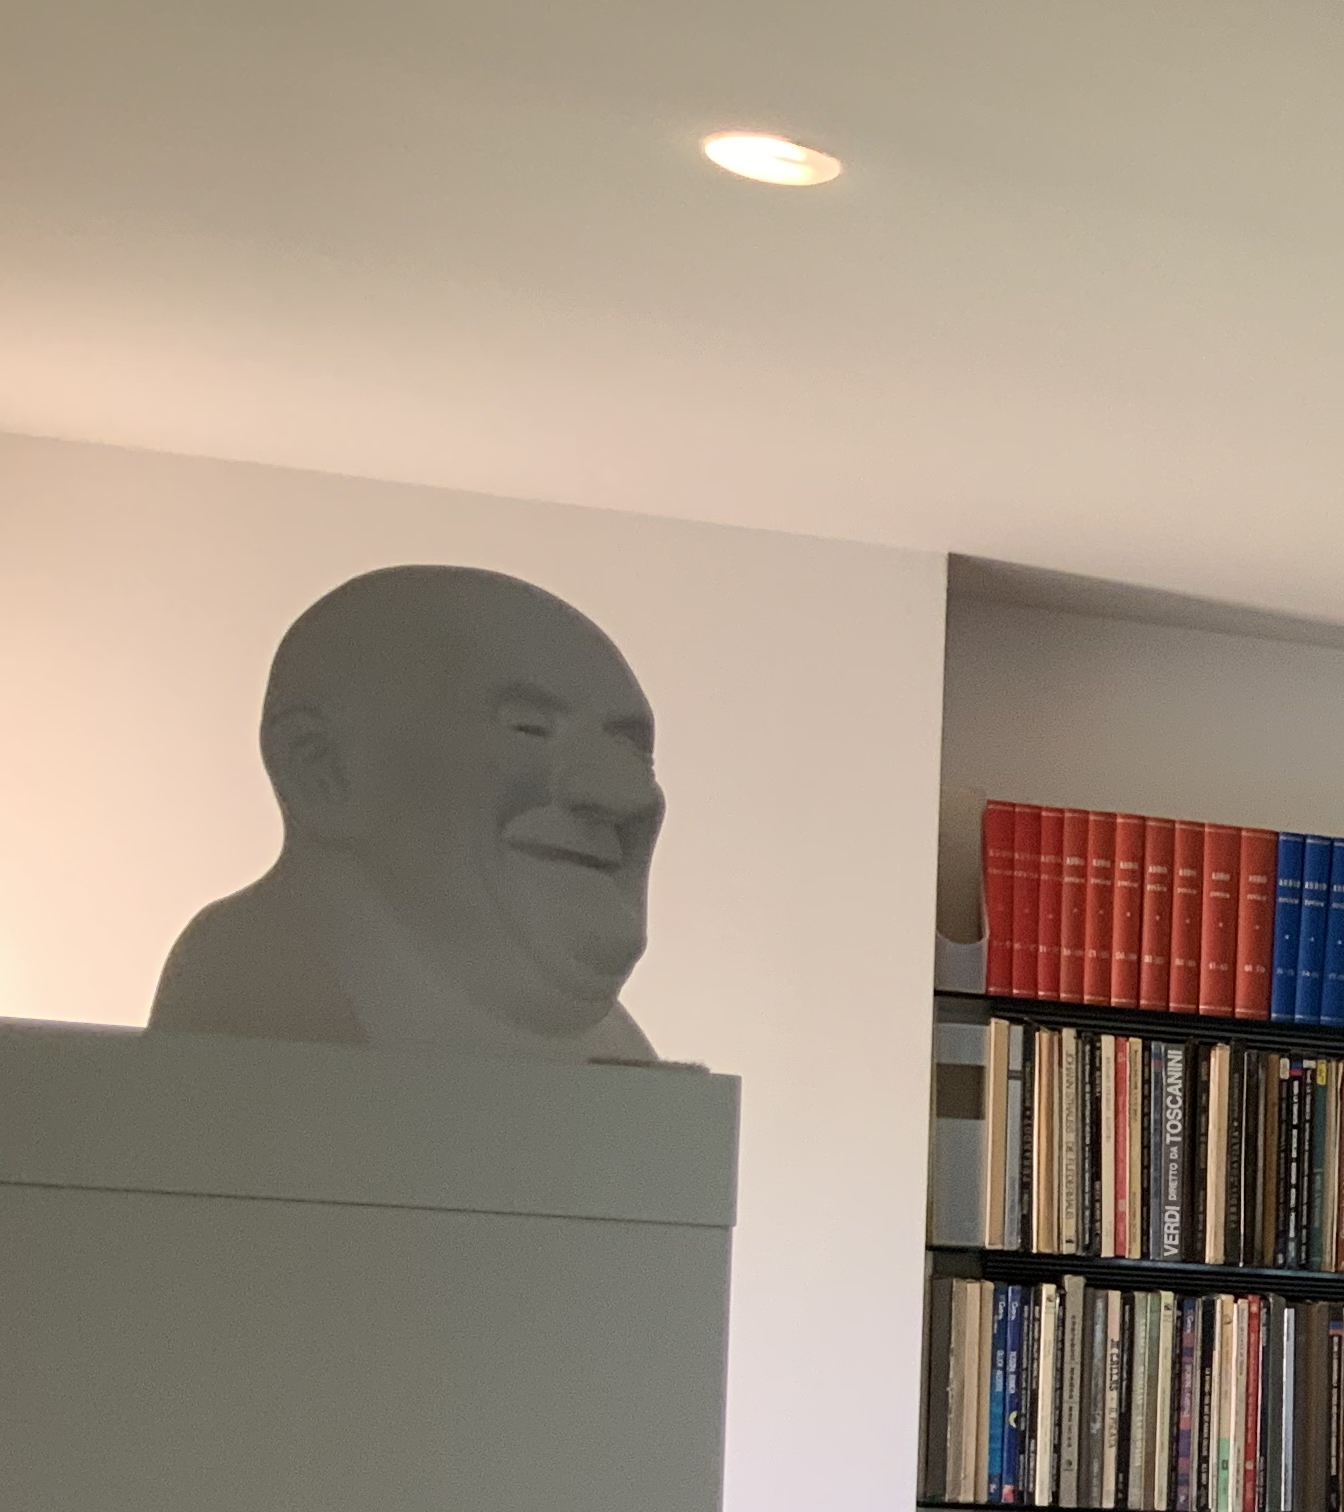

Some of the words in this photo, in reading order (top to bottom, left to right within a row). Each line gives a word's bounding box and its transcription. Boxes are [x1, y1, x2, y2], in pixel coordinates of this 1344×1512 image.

[1166, 1050, 1182, 1144] TOSCANINI
[1170, 1146, 1178, 1159] DA
[1169, 1163, 1178, 1200] DIRETTO
[1164, 1206, 1180, 1256] VERDI
